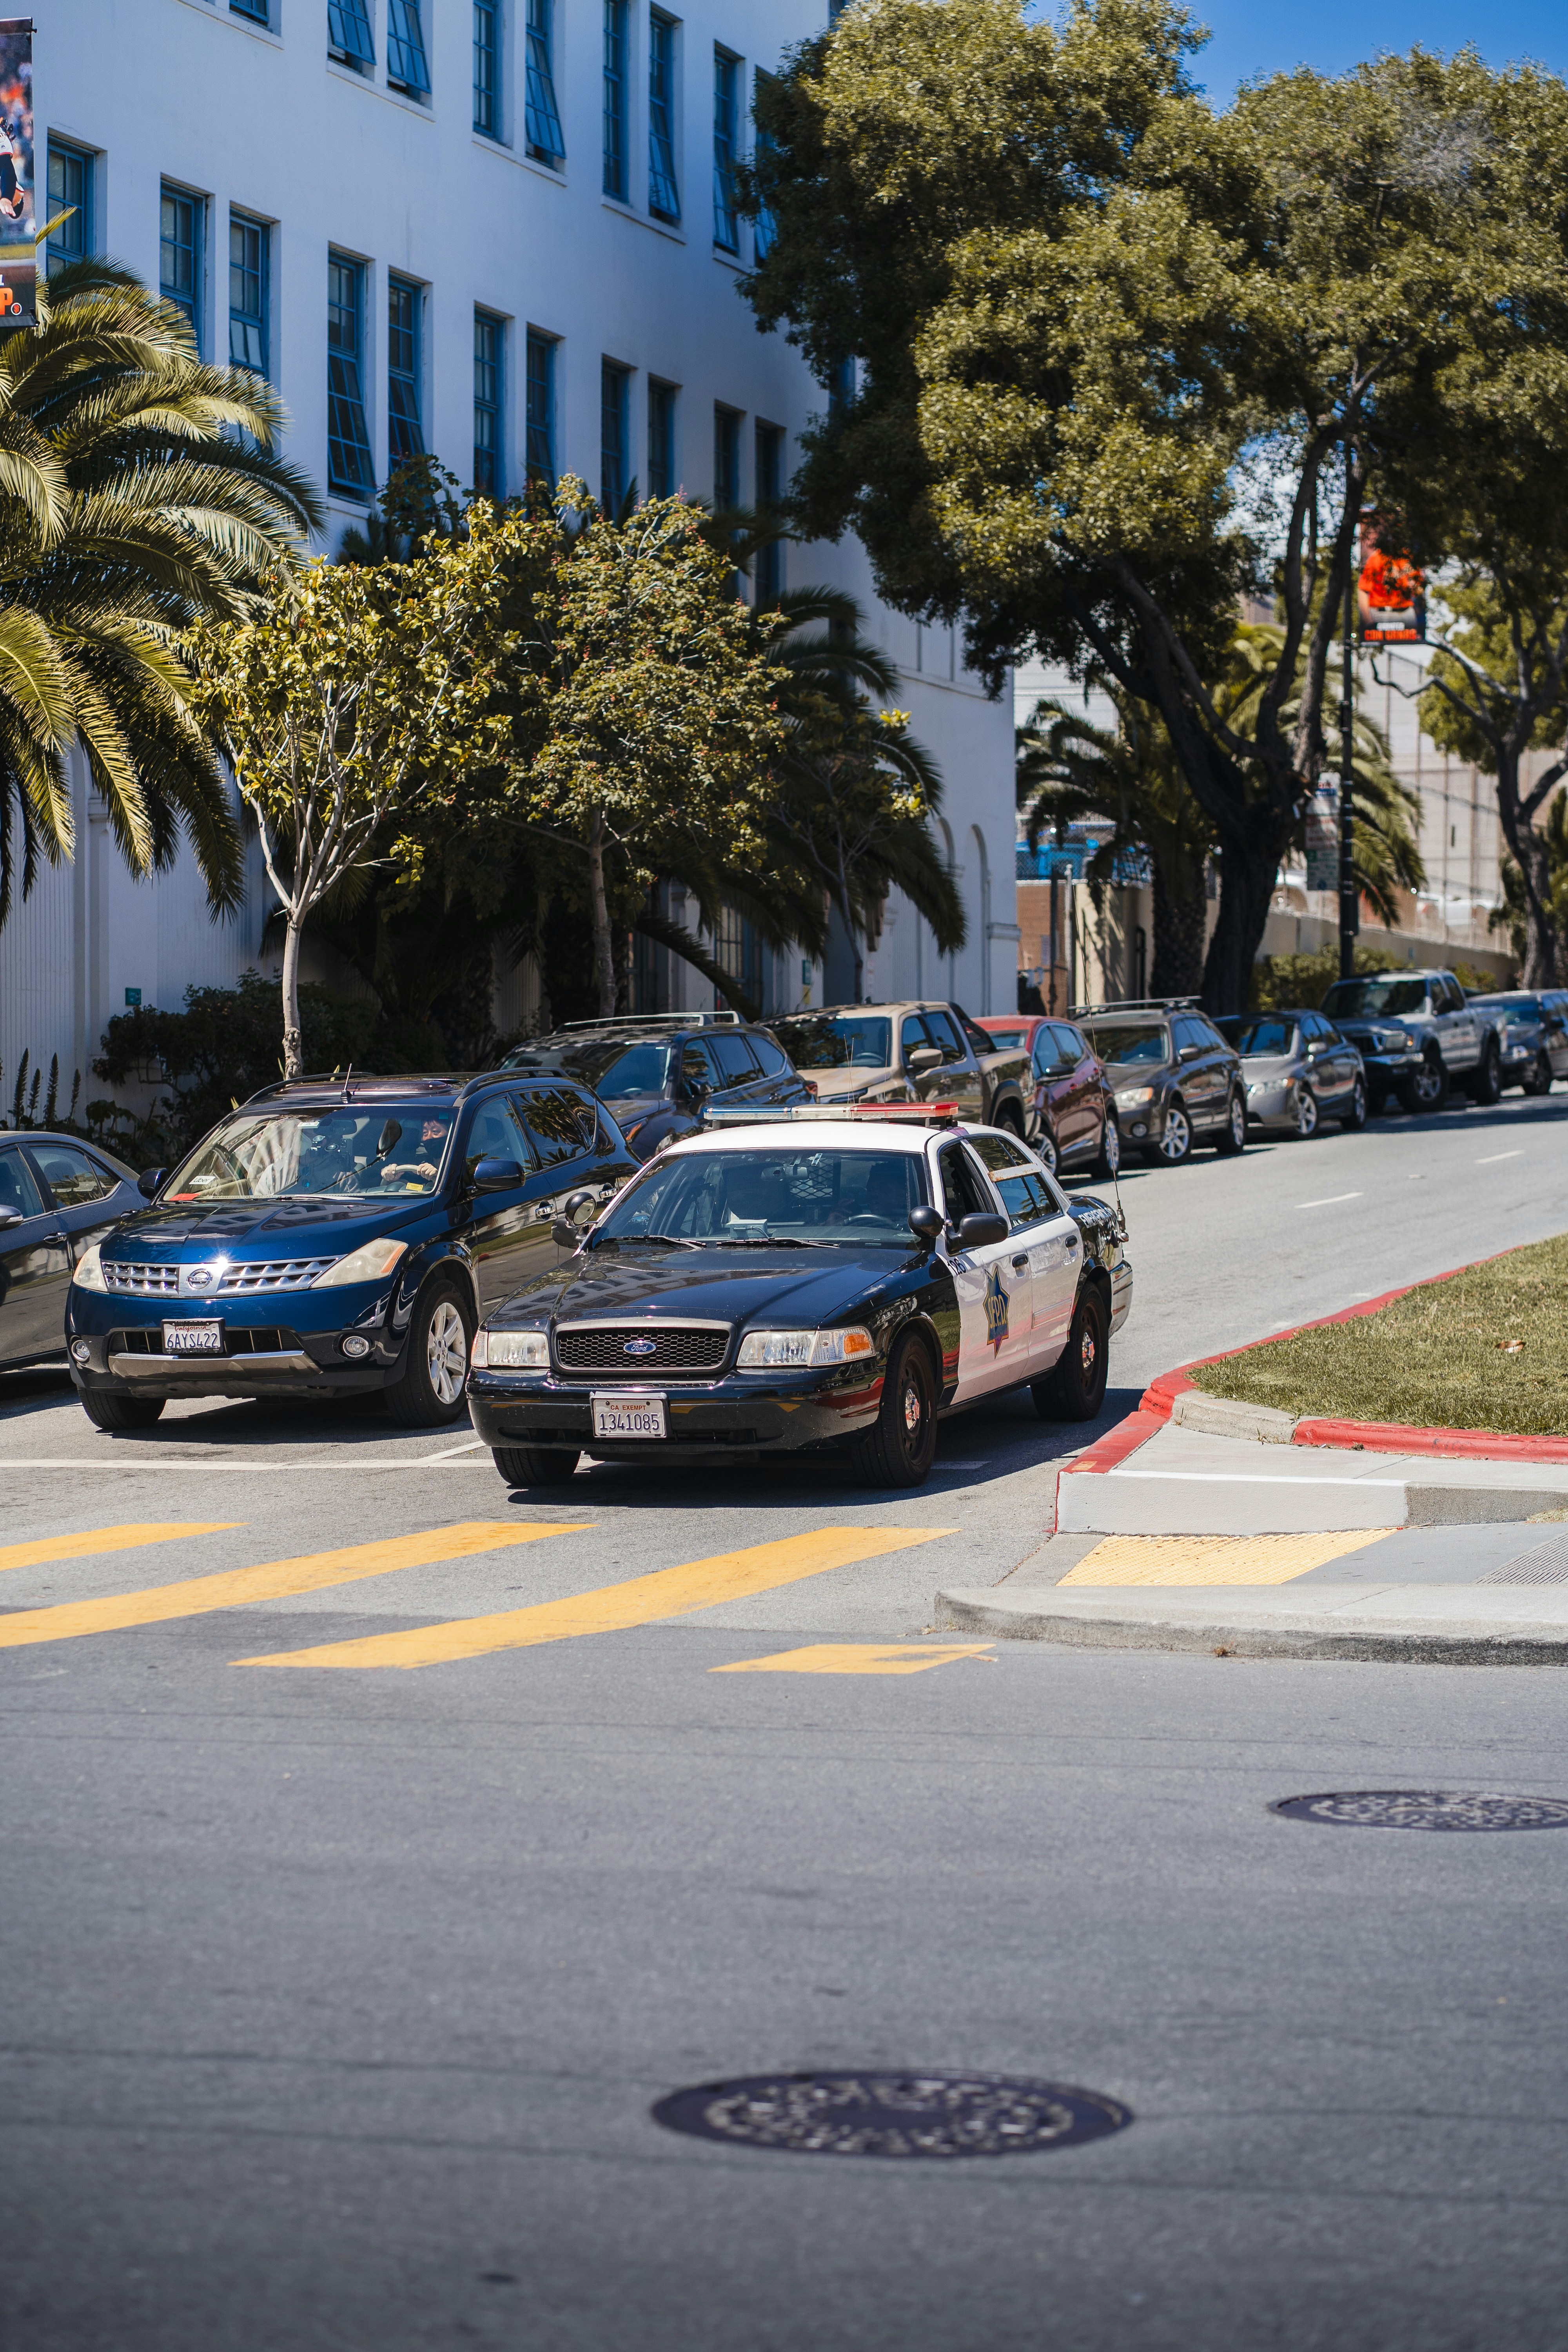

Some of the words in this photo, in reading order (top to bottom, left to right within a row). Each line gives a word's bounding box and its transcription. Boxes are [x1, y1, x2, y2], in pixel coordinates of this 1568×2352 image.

[947, 1258, 966, 1276] 126
[167, 1333, 218, 1348] 6AYS422
[631, 1343, 648, 1352] Ford
[599, 1414, 659, 1430] 1341085
